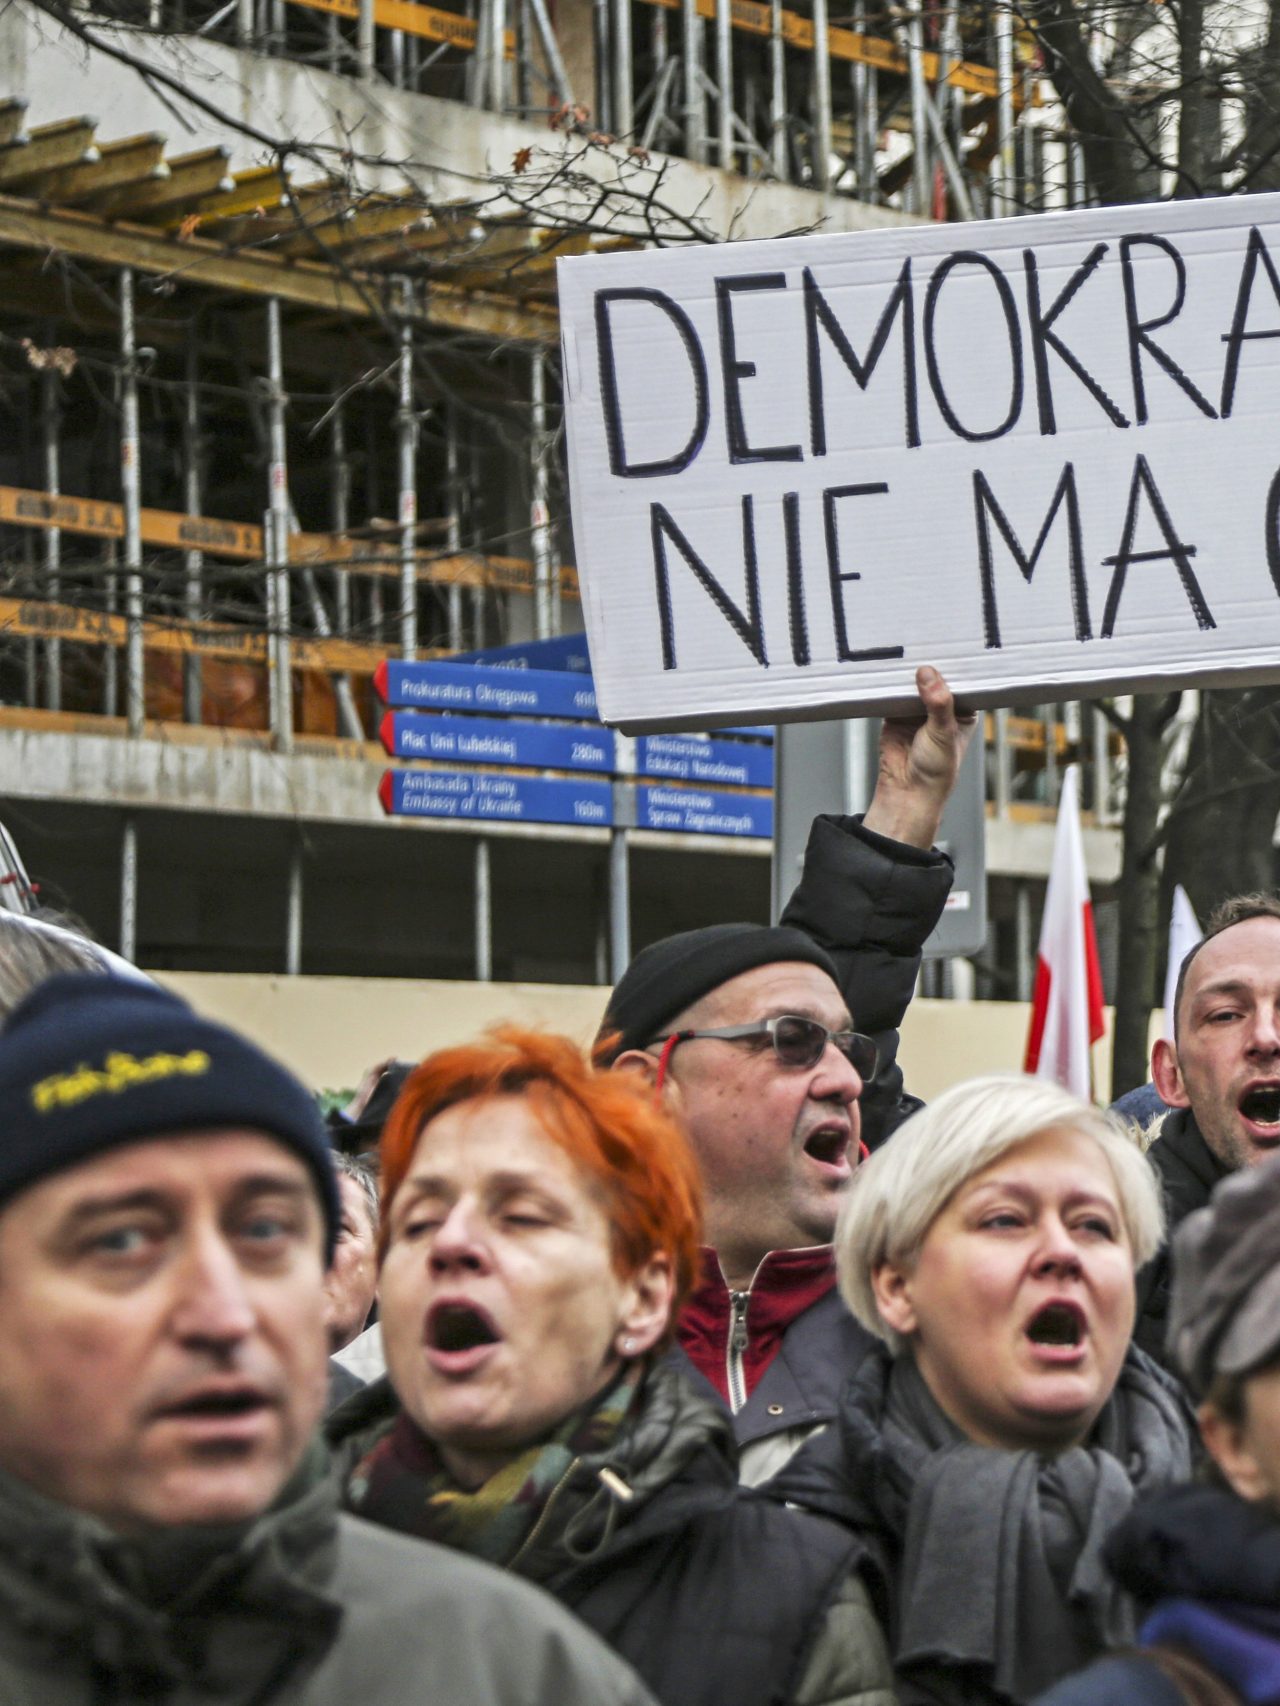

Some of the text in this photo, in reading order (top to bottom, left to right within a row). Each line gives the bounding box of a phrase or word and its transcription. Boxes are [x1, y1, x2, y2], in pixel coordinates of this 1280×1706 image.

[650, 482, 905, 671] NIE
[972, 453, 1217, 648] MA
[401, 679, 472, 700] Prokuratura
[574, 691, 597, 708] 400
[401, 730, 605, 762] Plac Unii Lubelskiej 280m
[402, 772, 469, 792] Ambasada
[692, 760, 748, 783] Narodowej
[402, 793, 605, 818] Embassy of Ukraine 160m
[648, 787, 713, 809] Ministerstwo
[648, 807, 752, 832] Spraw Zagranicznych
